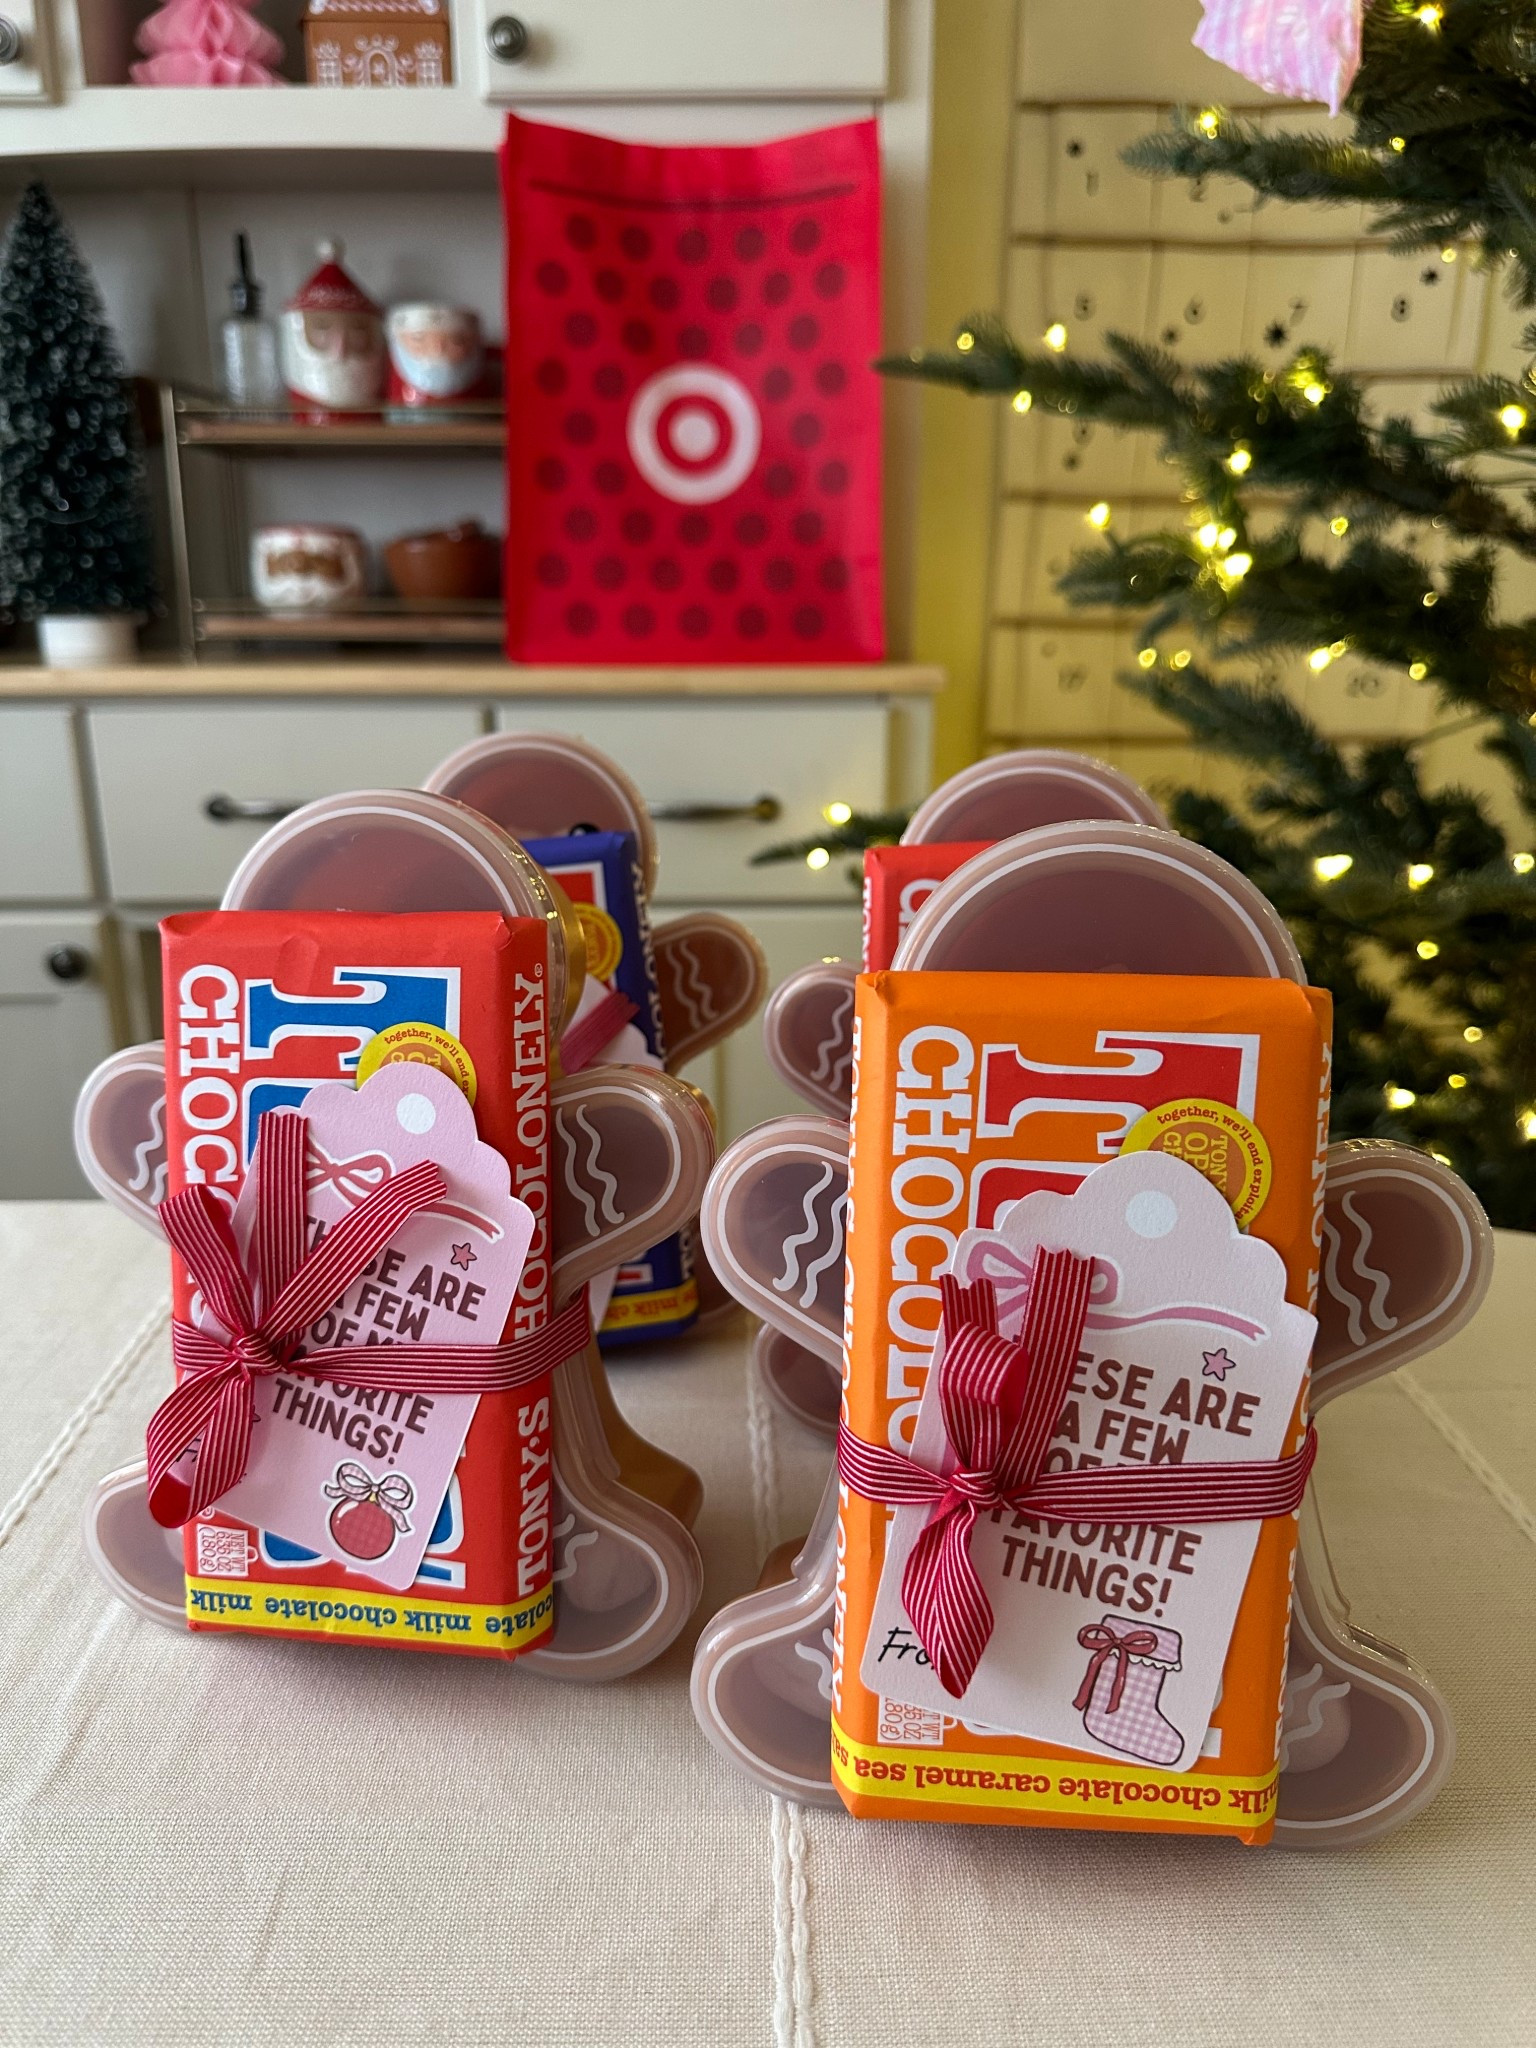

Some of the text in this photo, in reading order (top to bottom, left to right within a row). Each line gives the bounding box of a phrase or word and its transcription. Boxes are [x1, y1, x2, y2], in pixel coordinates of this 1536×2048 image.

[384, 1028, 433, 1045] together,
[435, 1035, 459, 1057] we'll
[456, 1058, 470, 1079] end
[1157, 1106, 1219, 1125] together,
[1222, 1114, 1252, 1142] we'll
[1247, 1142, 1263, 1167] end
[354, 1282, 430, 1342] FEW
[407, 1264, 487, 1322] ARE
[1067, 1350, 1261, 1437] ESE ARE
[272, 1378, 405, 1465] THINGS!
[1051, 1399, 1190, 1465] A FEW
[517, 1396, 550, 1598] TONY'S
[215, 1556, 232, 1573] OZ
[231, 1533, 246, 1572] NET WT
[1002, 1534, 1173, 1618] THINGS!
[191, 1589, 554, 1637] colate milk chocolate milk
[877, 1626, 936, 1671] Fro
[903, 1722, 922, 1740] OZ
[922, 1723, 940, 1740] WT
[854, 1756, 907, 1780] sea
[913, 1765, 1051, 1794] caramel
[1058, 1776, 1222, 1811] chocolate
